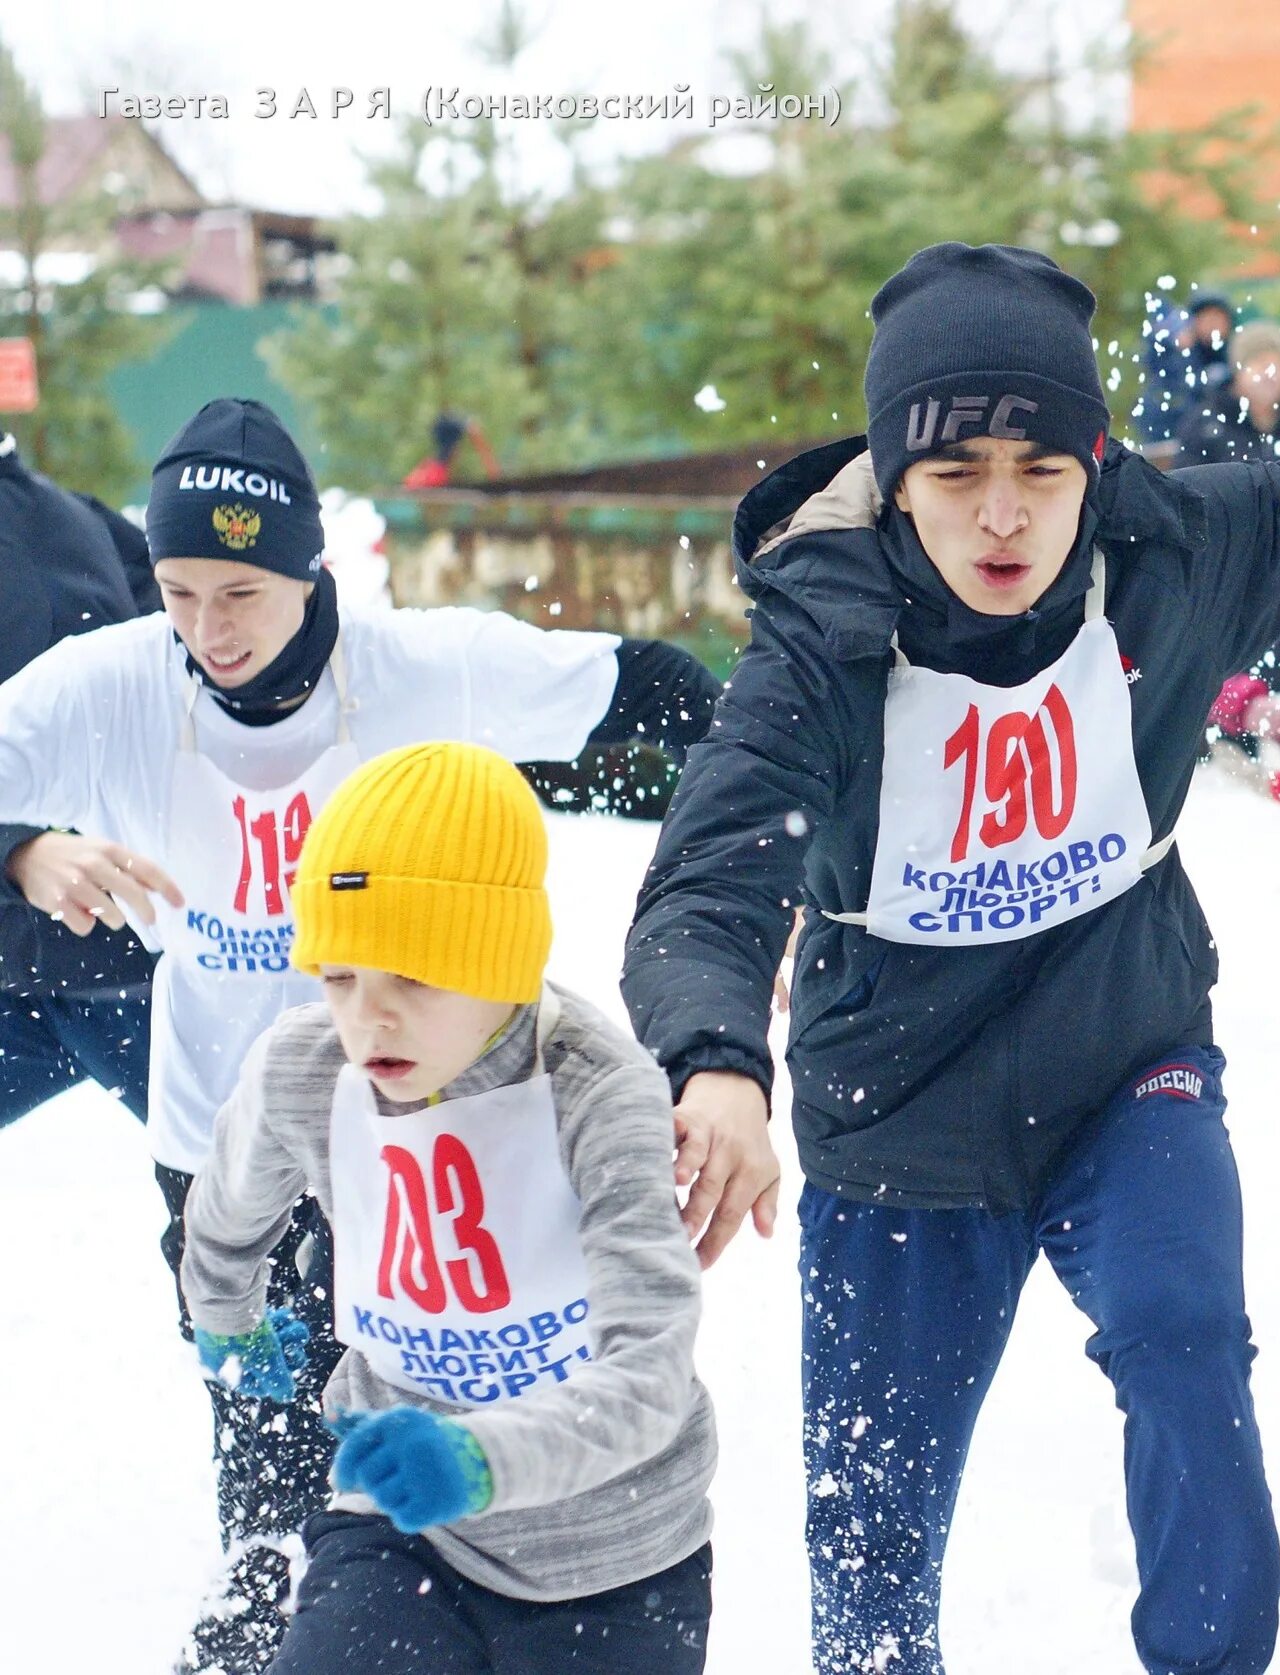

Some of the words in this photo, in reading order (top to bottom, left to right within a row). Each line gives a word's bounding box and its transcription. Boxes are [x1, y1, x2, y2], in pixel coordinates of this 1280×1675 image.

[906, 394, 1039, 451] UFC
[179, 466, 291, 506] LUKOIL
[944, 683, 1077, 863] 190
[902, 833, 1127, 892] КОНАКОВО
[188, 909, 294, 940] КОНАК
[197, 952, 290, 972] СПО
[1135, 1070, 1203, 1099] РОССИЯ
[353, 1298, 591, 1352] КОНАКОВО
[400, 1343, 551, 1377] ЛЮБИТ
[414, 1345, 592, 1403] ПОРТ!
